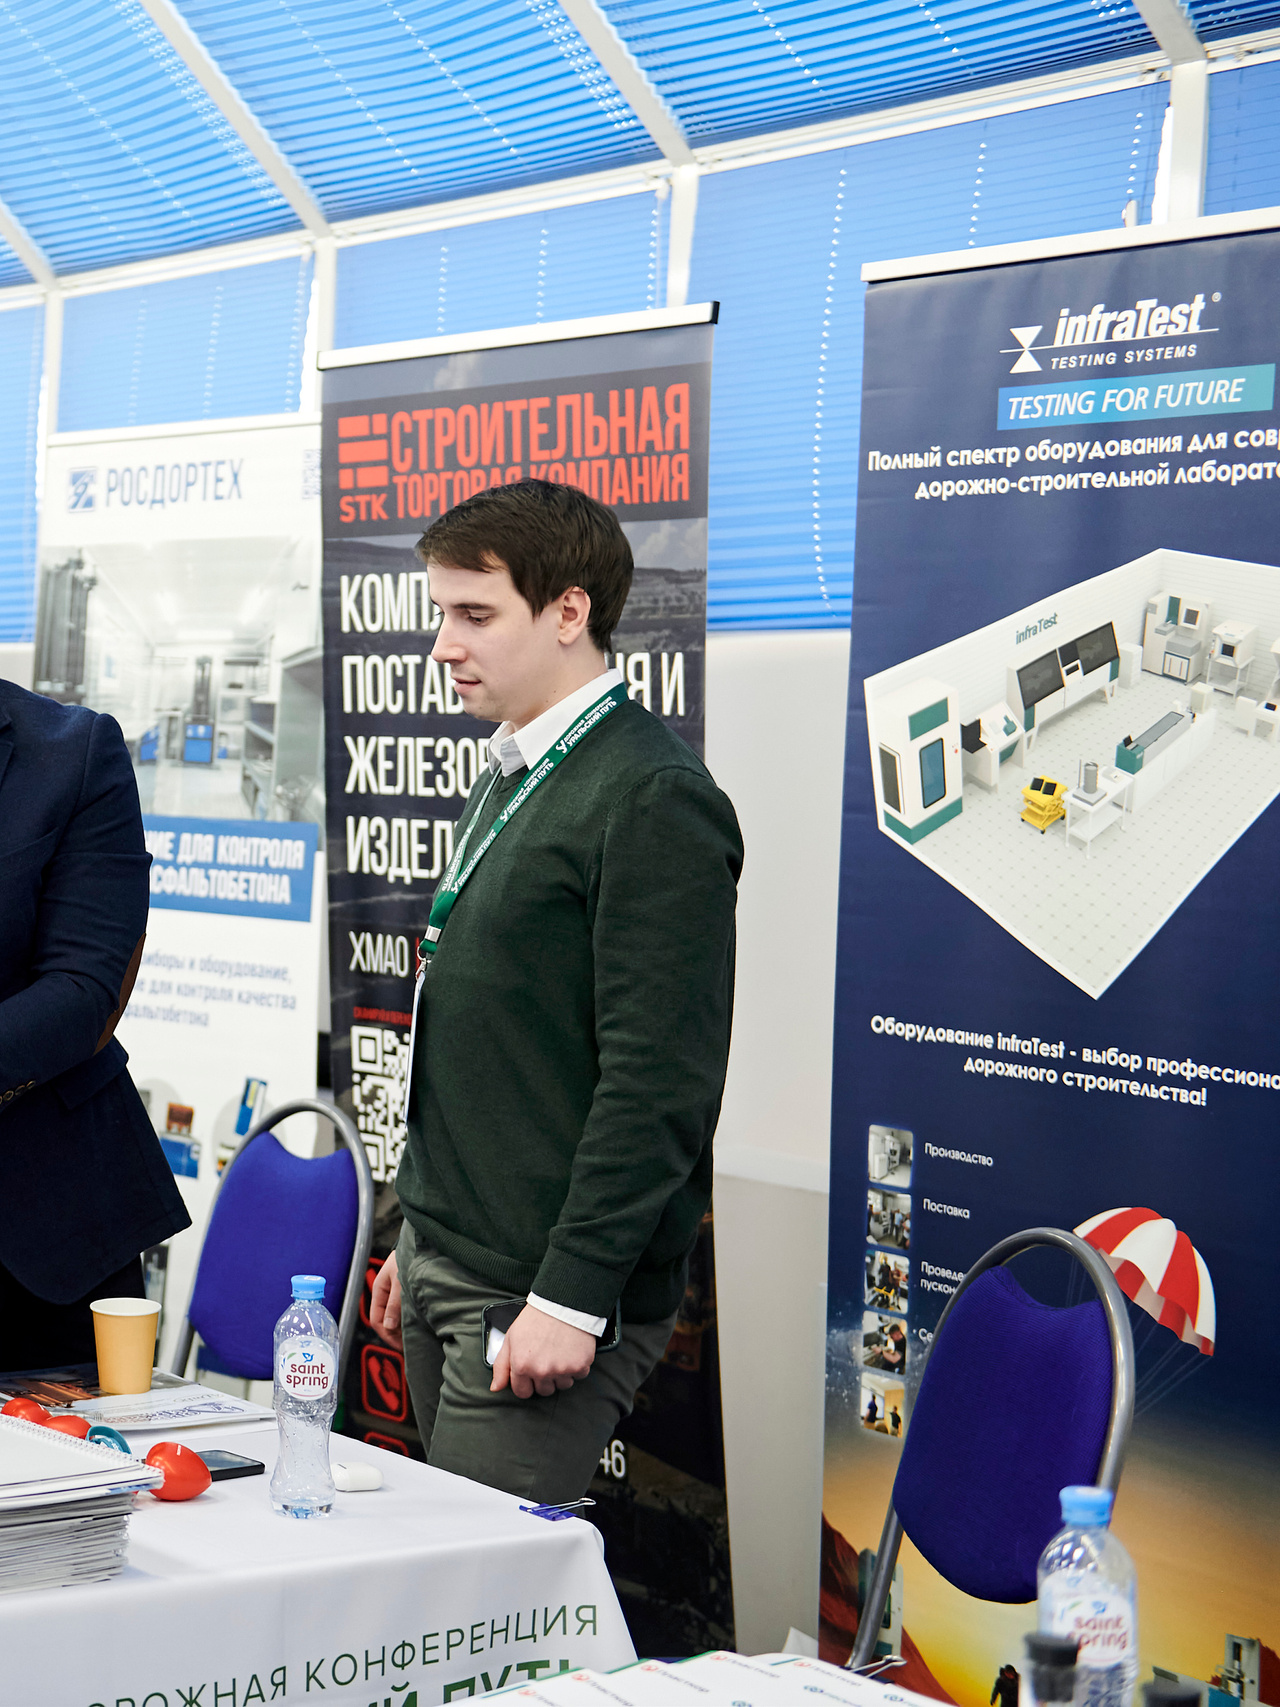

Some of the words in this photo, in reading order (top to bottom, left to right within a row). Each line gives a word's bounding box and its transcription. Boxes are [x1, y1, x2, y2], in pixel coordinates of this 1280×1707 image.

[1052, 294, 1205, 347] infraTest
[1050, 353, 1117, 370] TESTING
[1125, 345, 1197, 363] SYSTEMS
[1008, 391, 1094, 420] TESTING
[1101, 386, 1149, 413] FOR
[1153, 378, 1245, 409] FUTURE
[391, 382, 690, 474] СТРОИТЕЛЬНАЯ
[868, 446, 942, 471] Полный
[946, 446, 1020, 468] спектр
[1025, 433, 1182, 461] оборудования
[1187, 428, 1227, 452] для
[1234, 428, 1280, 451] сов
[106, 458, 244, 510] РОСДОРТЕХ
[915, 463, 1170, 501] дорожно-строительной
[1174, 459, 1280, 486] лаборат
[339, 492, 389, 524] STK
[340, 571, 441, 632] КОМП
[660, 651, 685, 717] И
[566, 711, 602, 747] УРАЛЬСКИЙ
[599, 700, 617, 716] ПУТЬ
[536, 762, 554, 780] ПУТЬ
[177, 832, 215, 865] ДЛЯ
[217, 835, 306, 871] КОНТРОЛЯ
[345, 815, 458, 884] ИЗДЕЛ
[150, 864, 291, 905] СФАЛЬТОБЕТОНА
[348, 930, 409, 978] ХМАО
[871, 1015, 994, 1050] Оборудование
[997, 1031, 1065, 1060] infraTest
[1082, 1047, 1143, 1072] выбор
[963, 1056, 1058, 1085] дорожного
[1062, 1070, 1208, 1107] строительства!
[925, 1142, 994, 1167] Производство
[923, 1198, 970, 1219] Поставка
[921, 1261, 966, 1283] Проведе
[286, 1375, 329, 1390] spring
[290, 1363, 326, 1375] saint
[1074, 1614, 1124, 1630] saint
[305, 1604, 598, 1692] КОНФЕРЕНЦИЯ
